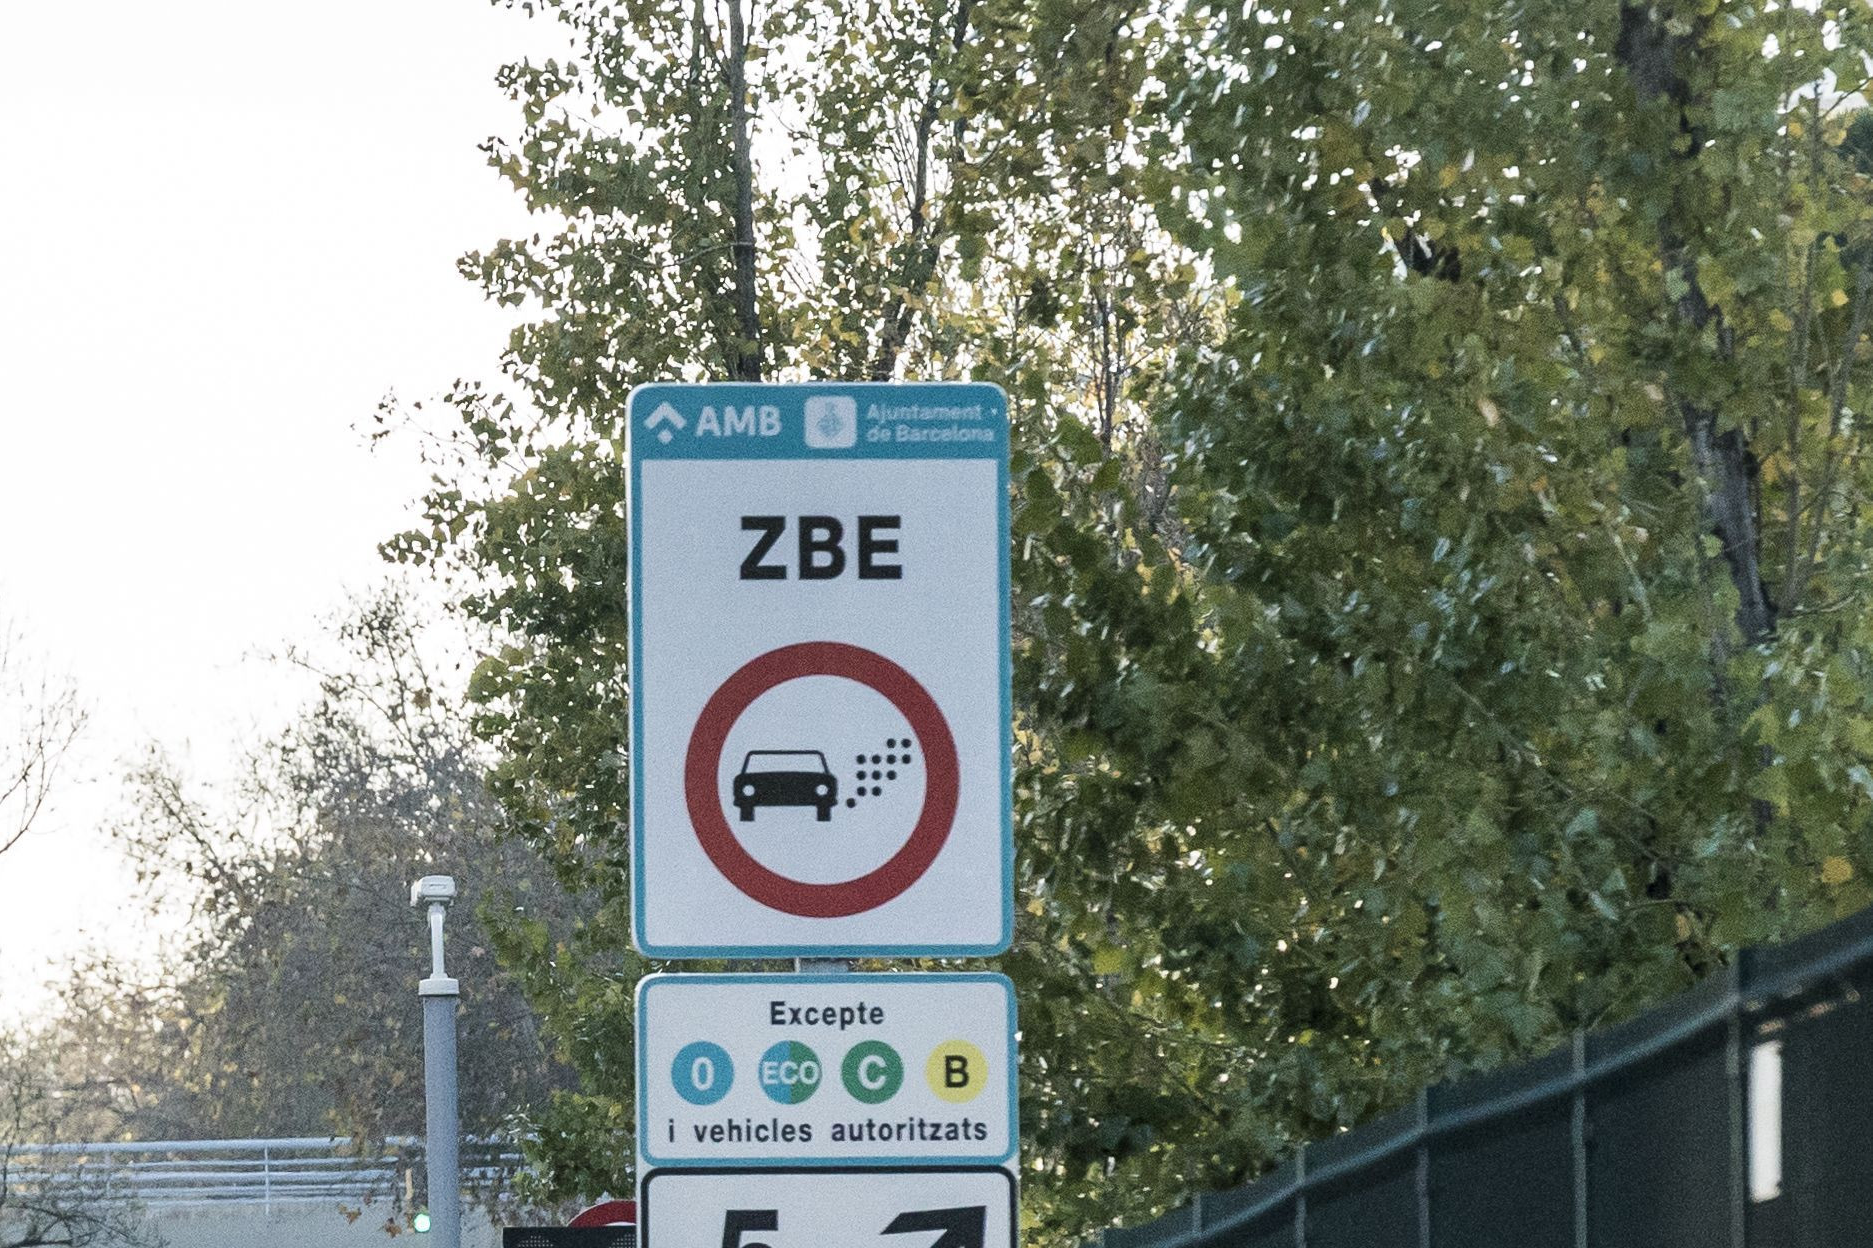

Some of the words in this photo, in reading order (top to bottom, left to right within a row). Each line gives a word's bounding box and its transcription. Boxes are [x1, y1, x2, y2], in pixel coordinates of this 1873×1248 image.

[695, 405, 783, 438] AMB
[867, 403, 982, 424] Ajuntament
[867, 424, 892, 442] de
[895, 424, 994, 442] Barcelona
[739, 515, 904, 582] ZBE
[770, 1001, 885, 1031] Excepte
[691, 1056, 716, 1092] 0
[761, 1059, 821, 1086] ECO
[857, 1055, 887, 1091] C
[944, 1055, 971, 1089] B
[668, 1119, 676, 1143] i
[693, 1118, 814, 1144] vehicles
[831, 1117, 989, 1143] autoritzats
